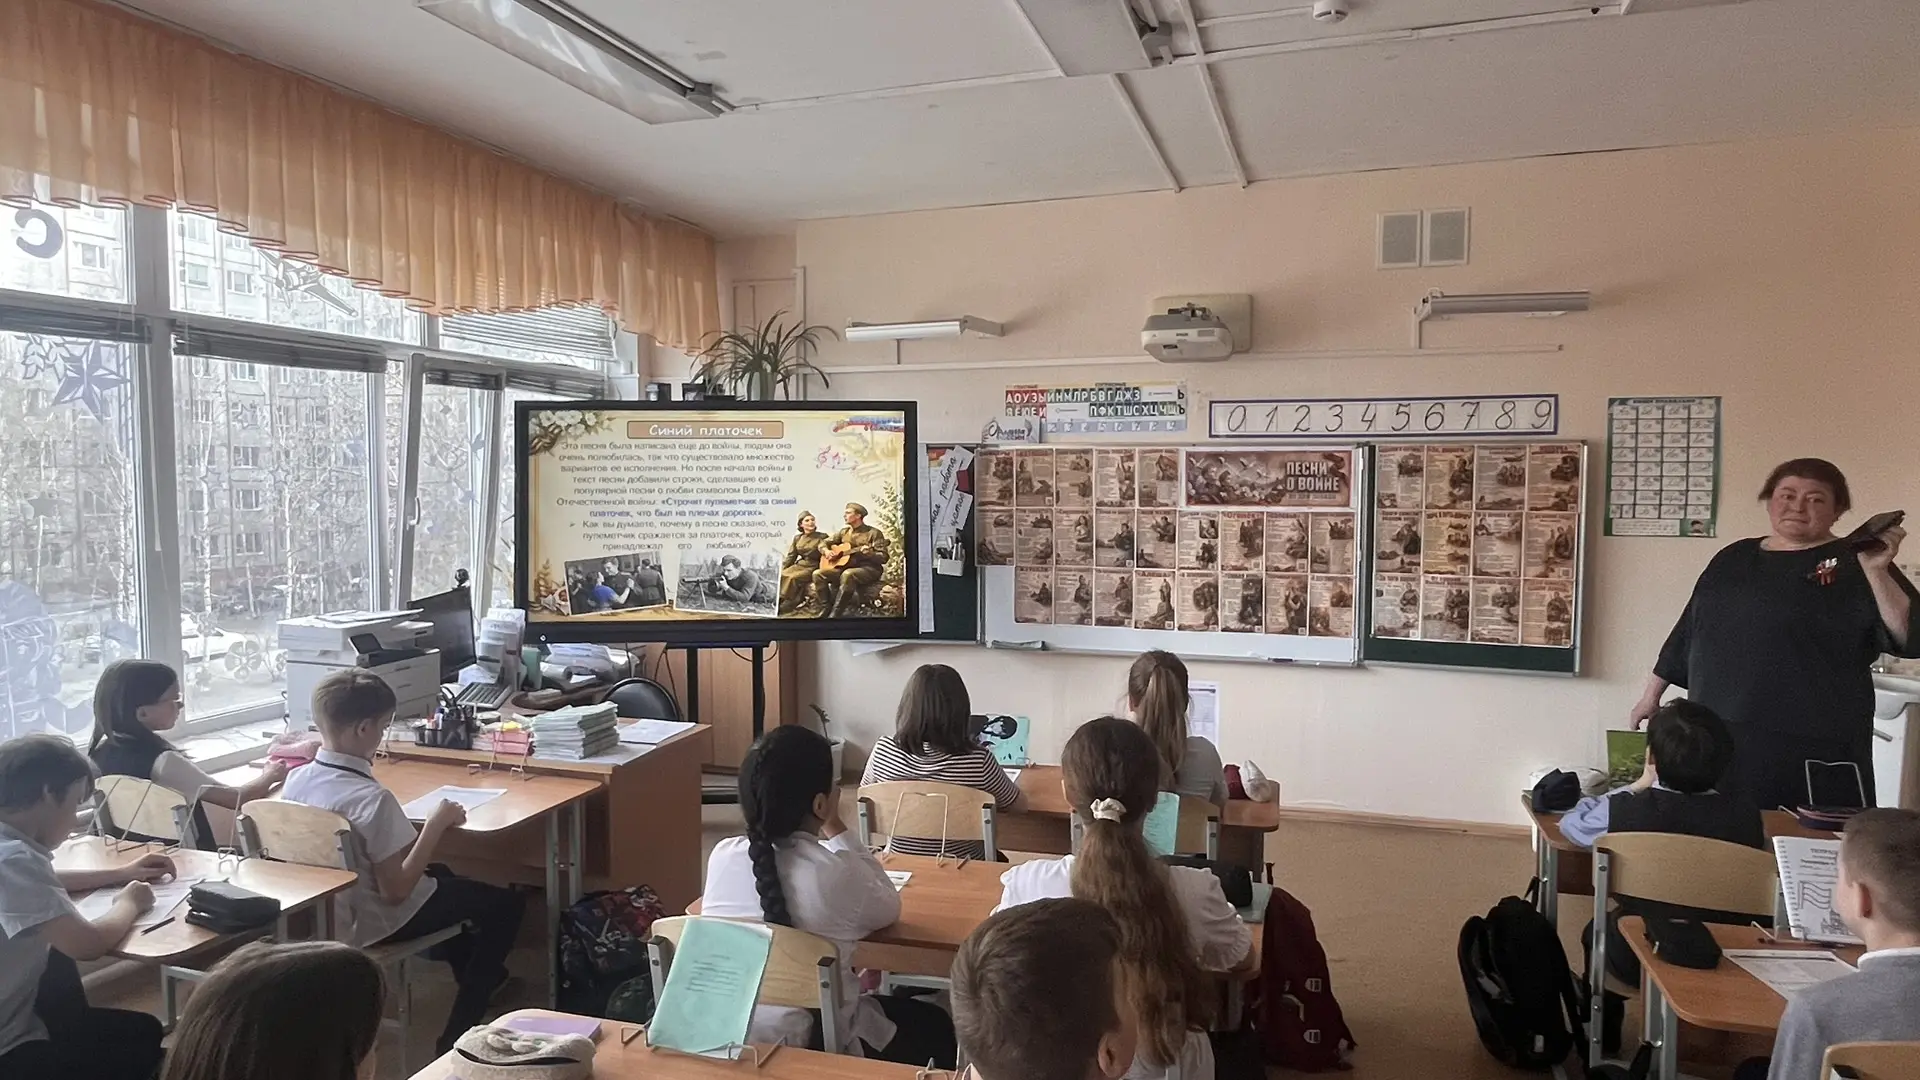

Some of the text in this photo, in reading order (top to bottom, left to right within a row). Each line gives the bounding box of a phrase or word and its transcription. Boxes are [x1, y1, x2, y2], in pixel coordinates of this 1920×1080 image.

[649, 424, 763, 436] Синий платочек
[609, 442, 632, 450] была
[587, 453, 644, 462] полюбилась,
[681, 454, 744, 462] существовало
[1286, 461, 1327, 475] ПЕСНИ
[627, 475, 670, 484] добавили
[672, 476, 704, 484] строки,
[706, 476, 756, 484] сделавшие
[1286, 477, 1294, 490] О
[574, 487, 627, 496] популярной
[665, 486, 694, 494] любви
[556, 497, 625, 506] Отечественной
[661, 497, 702, 507] «Строчит
[704, 498, 757, 507] пулеметчик
[771, 497, 797, 505] синий
[616, 521, 657, 529] думаете,
[582, 533, 635, 541] пулеметчик
[638, 532, 686, 540] сражается
[745, 531, 782, 539] который
[603, 543, 663, 551] принадлежал
[706, 541, 751, 549] любимой?
